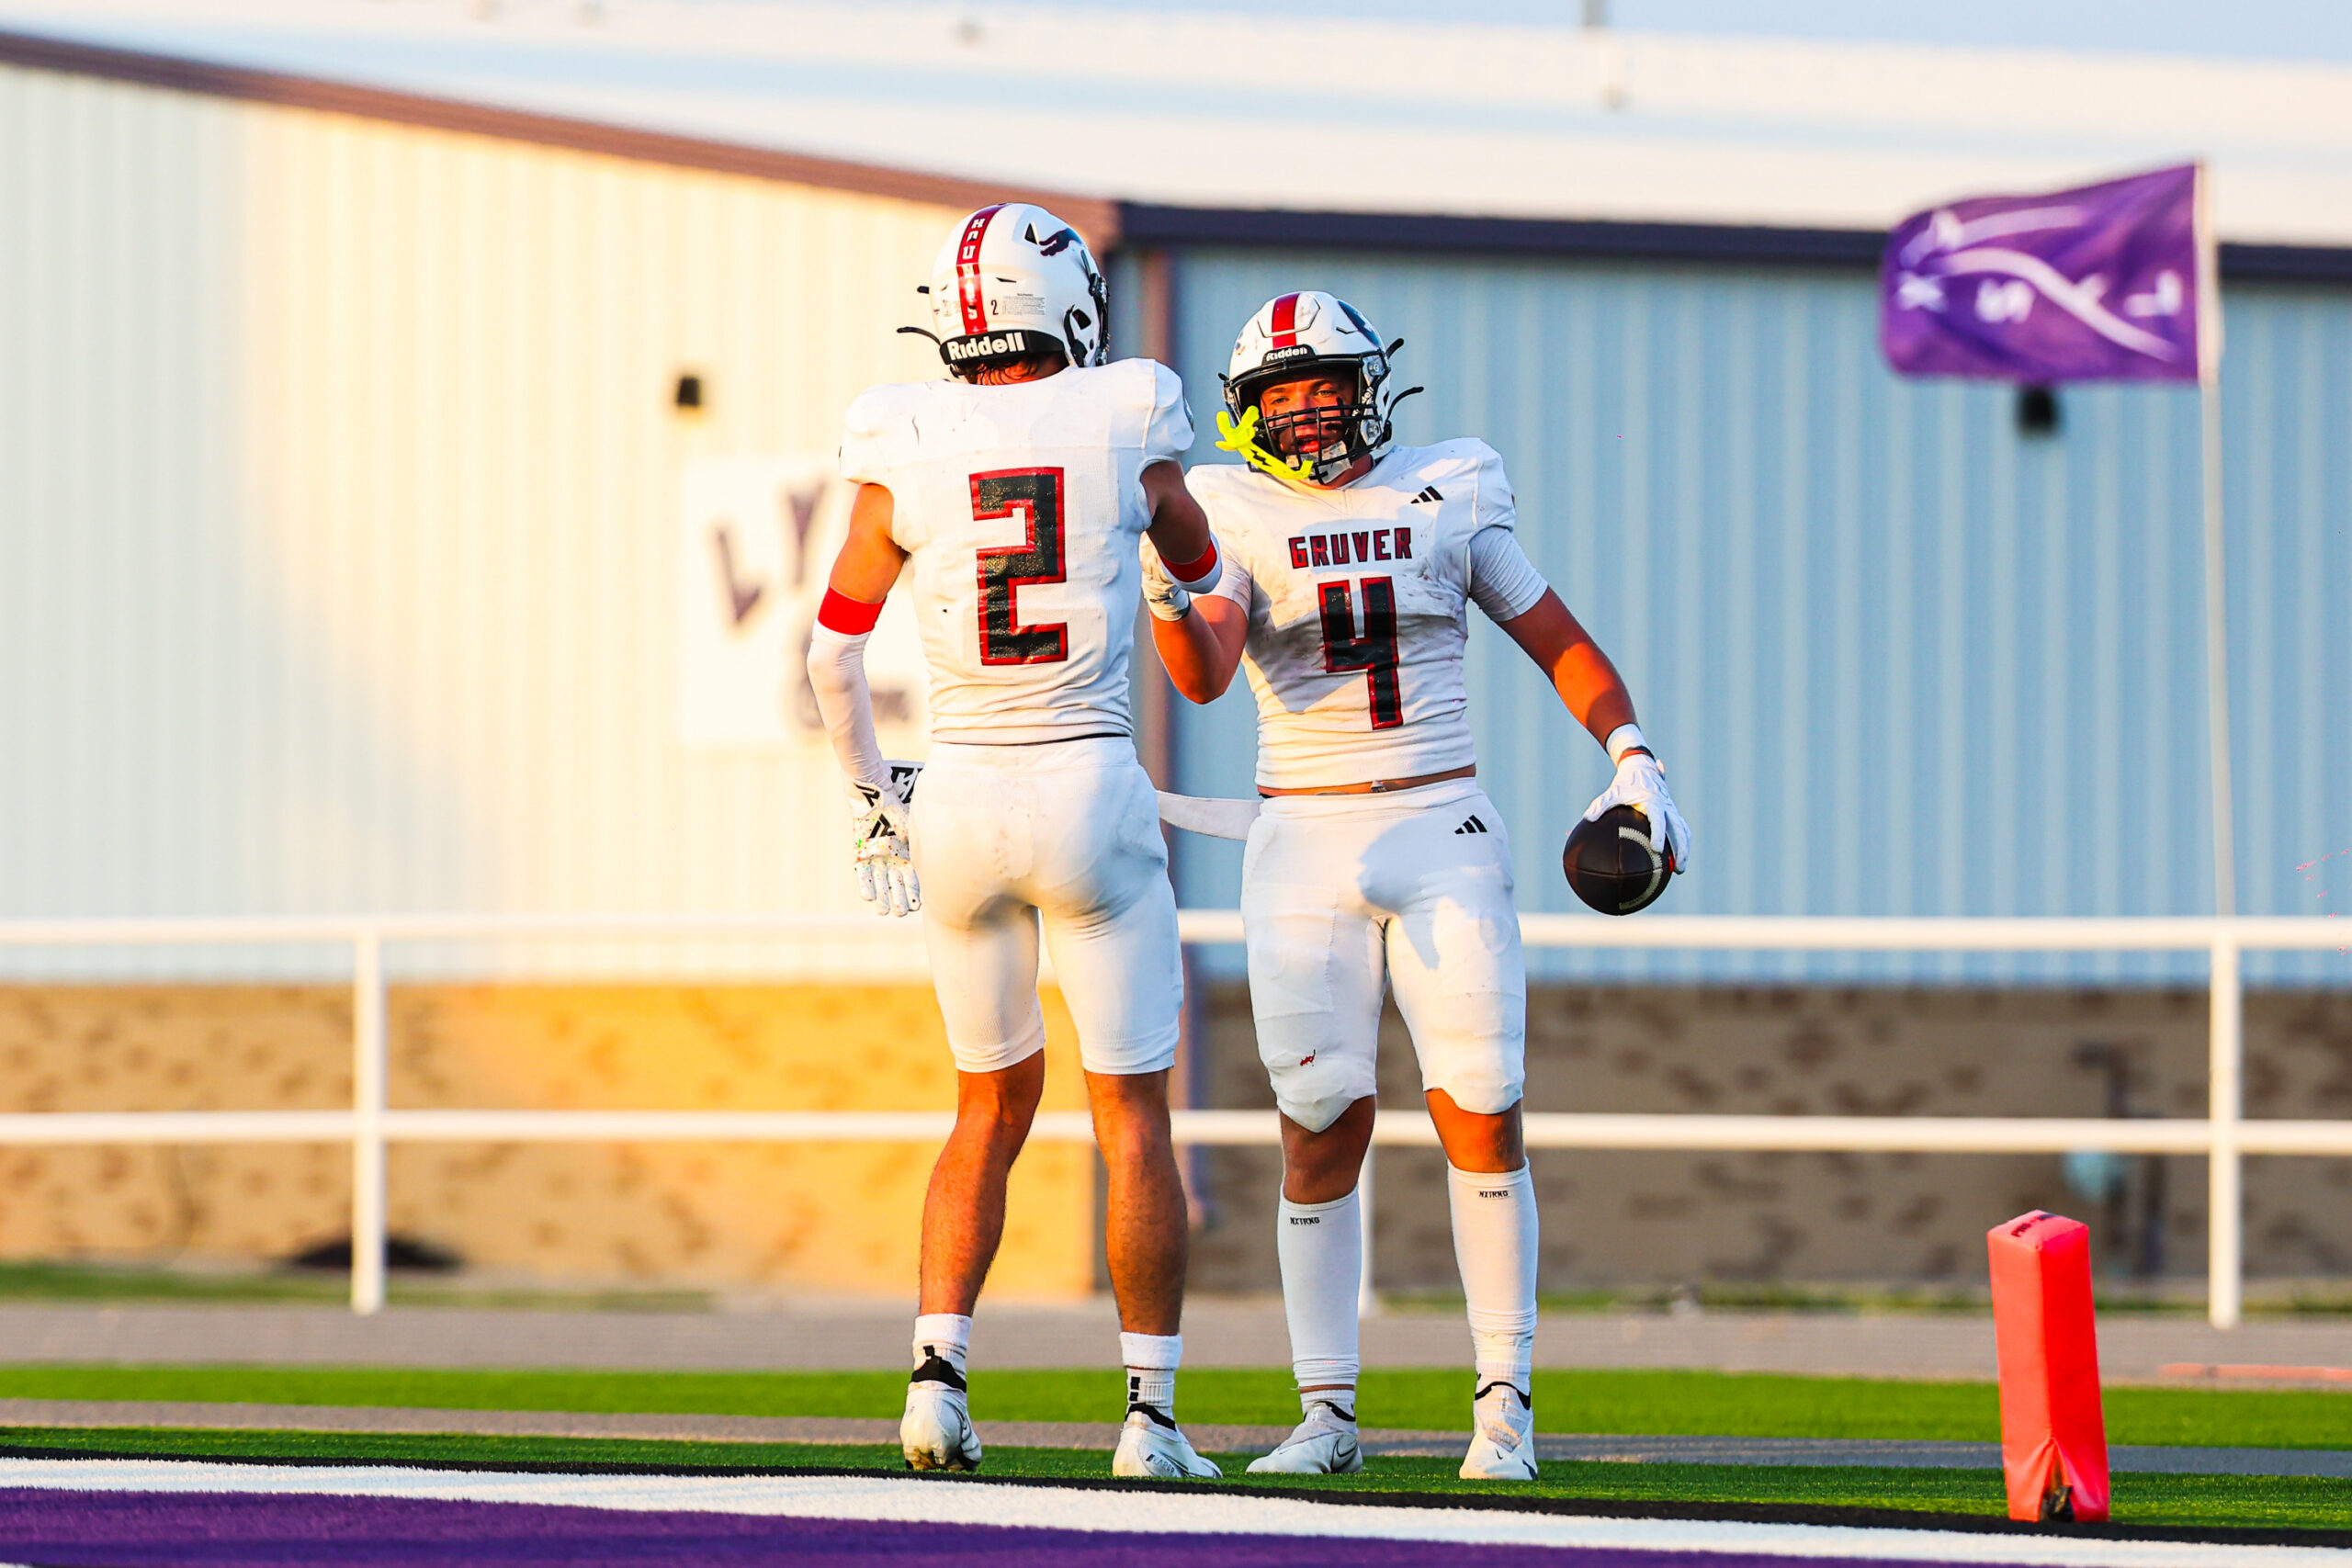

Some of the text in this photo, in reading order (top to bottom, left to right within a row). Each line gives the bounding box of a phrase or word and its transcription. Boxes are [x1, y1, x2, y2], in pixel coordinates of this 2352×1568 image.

[990, 299, 999, 316] 2
[946, 332, 1025, 361] Riddell
[968, 467, 1068, 666] 2
[1288, 527, 1412, 569] GRUVER
[1317, 576, 1403, 730] 4
